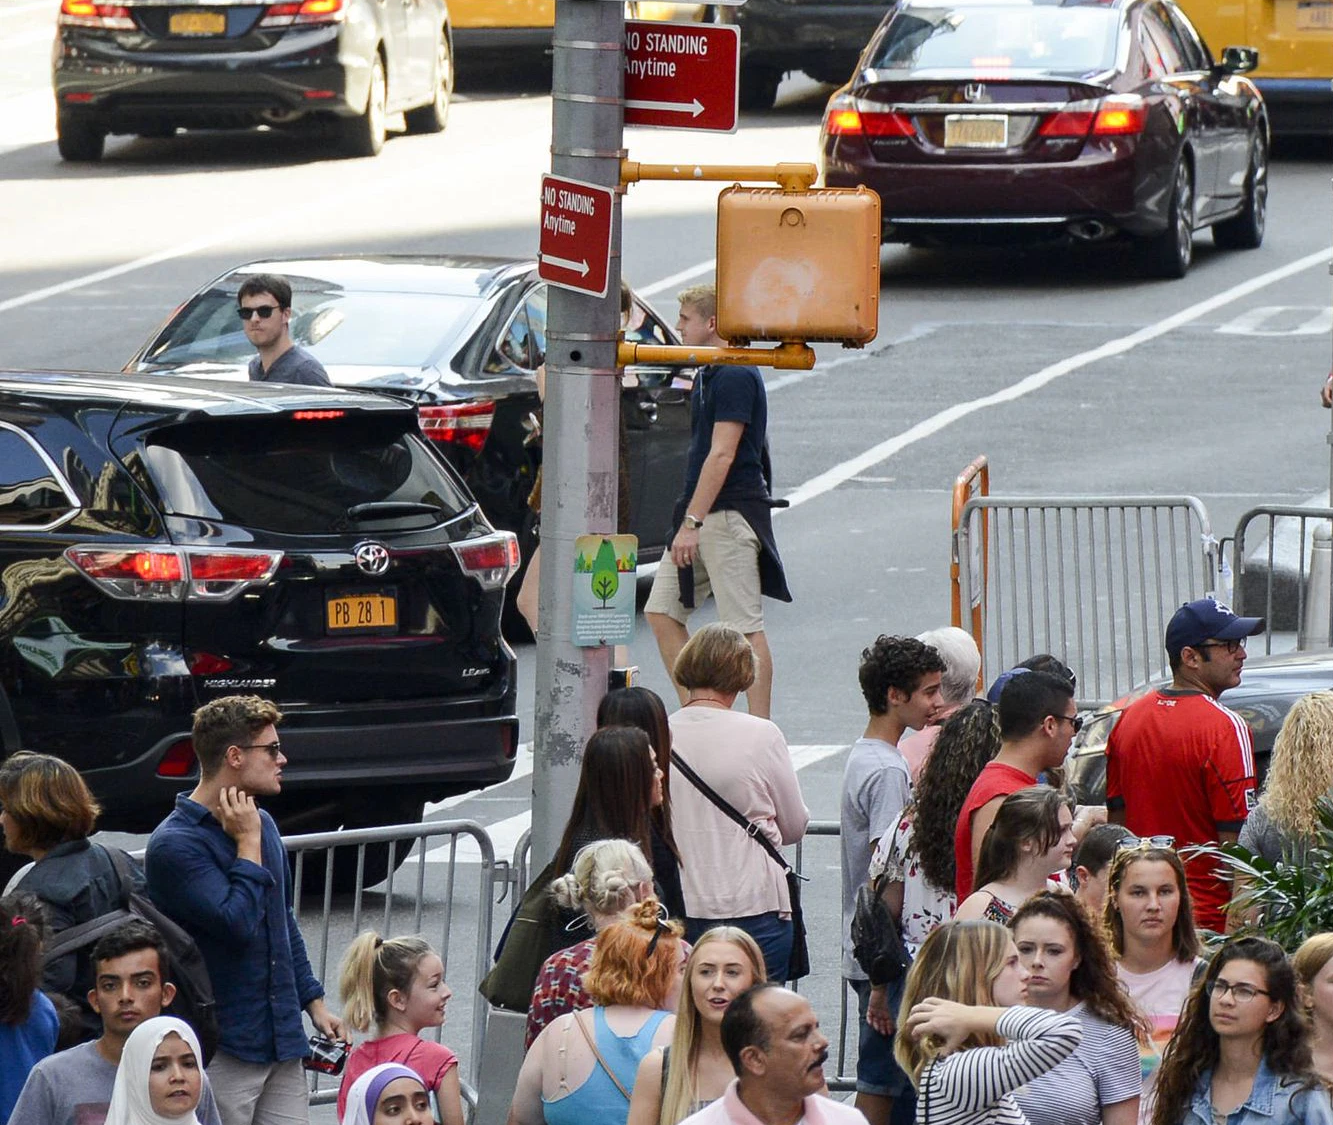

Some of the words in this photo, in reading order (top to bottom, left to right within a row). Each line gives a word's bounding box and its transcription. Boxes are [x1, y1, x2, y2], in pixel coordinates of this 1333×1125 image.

[645, 32, 708, 56] STANDING
[624, 56, 677, 80] Anytime
[544, 186, 556, 207] NO
[558, 189, 595, 216] STANDING
[543, 210, 576, 236] Anytime
[335, 600, 350, 625] PB
[357, 600, 373, 624] 28
[380, 600, 386, 623] 1
[204, 678, 277, 689] HIGHLANDER
